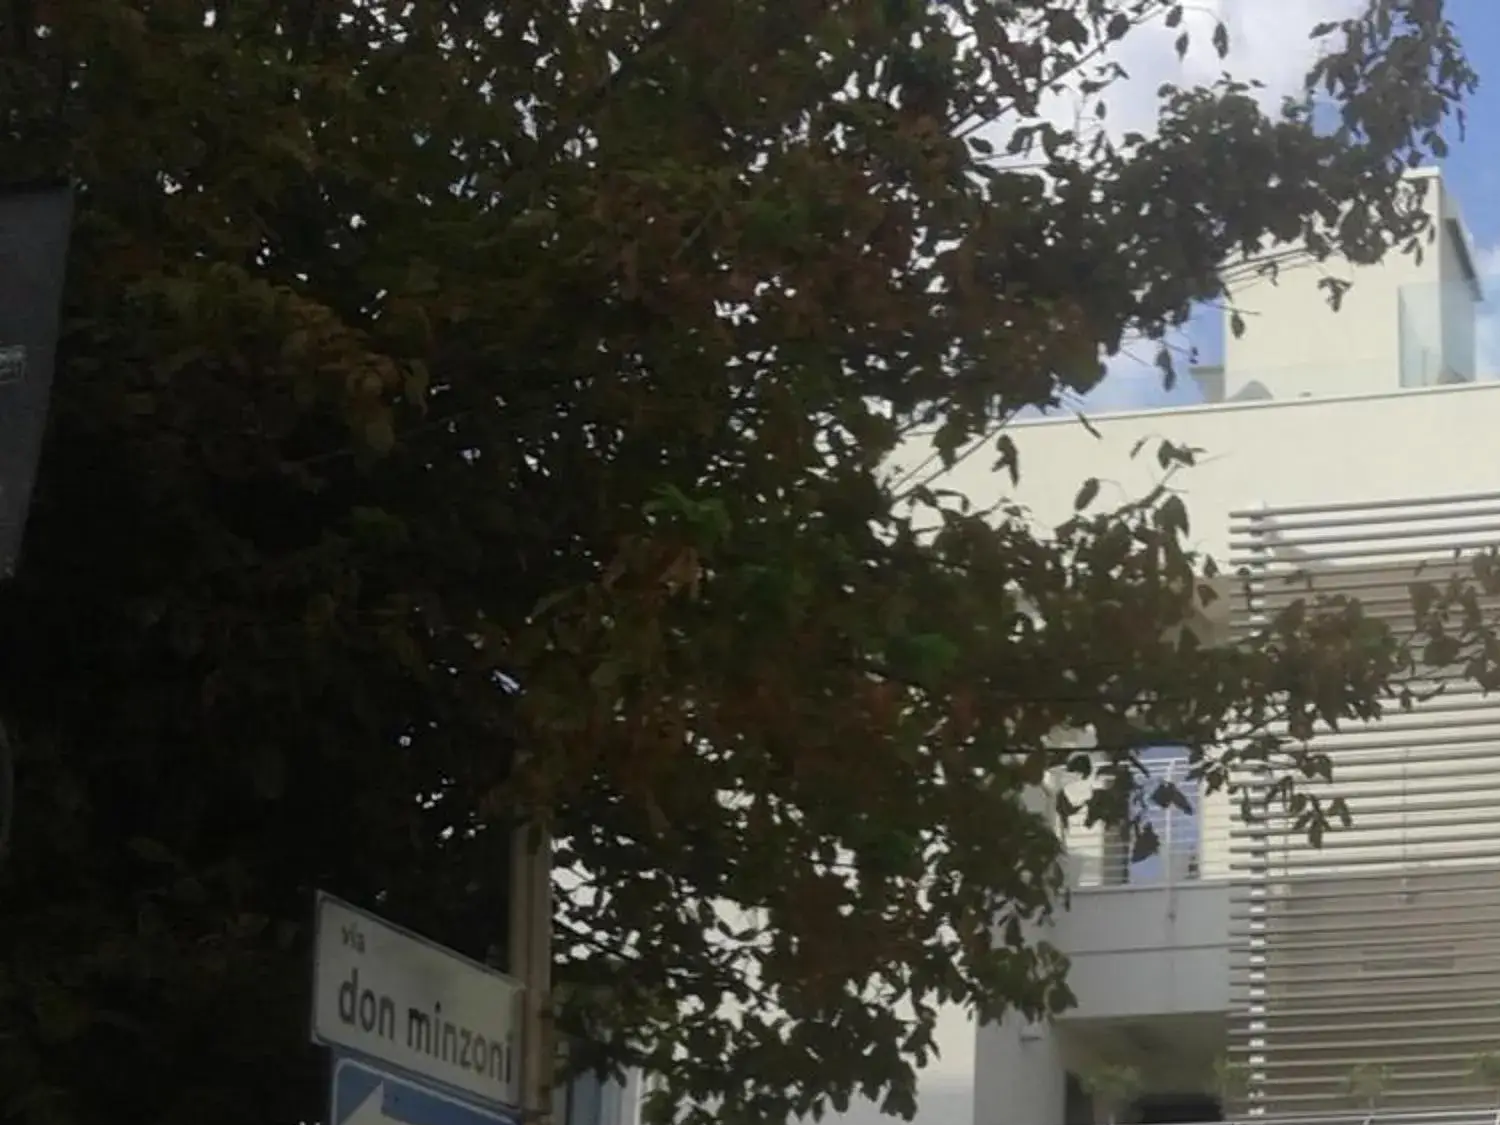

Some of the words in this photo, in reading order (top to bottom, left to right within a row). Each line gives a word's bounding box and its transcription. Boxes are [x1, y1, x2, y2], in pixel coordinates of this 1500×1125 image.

[341, 920, 366, 953] via
[339, 968, 396, 1040] don
[406, 1001, 514, 1084] minzoni
